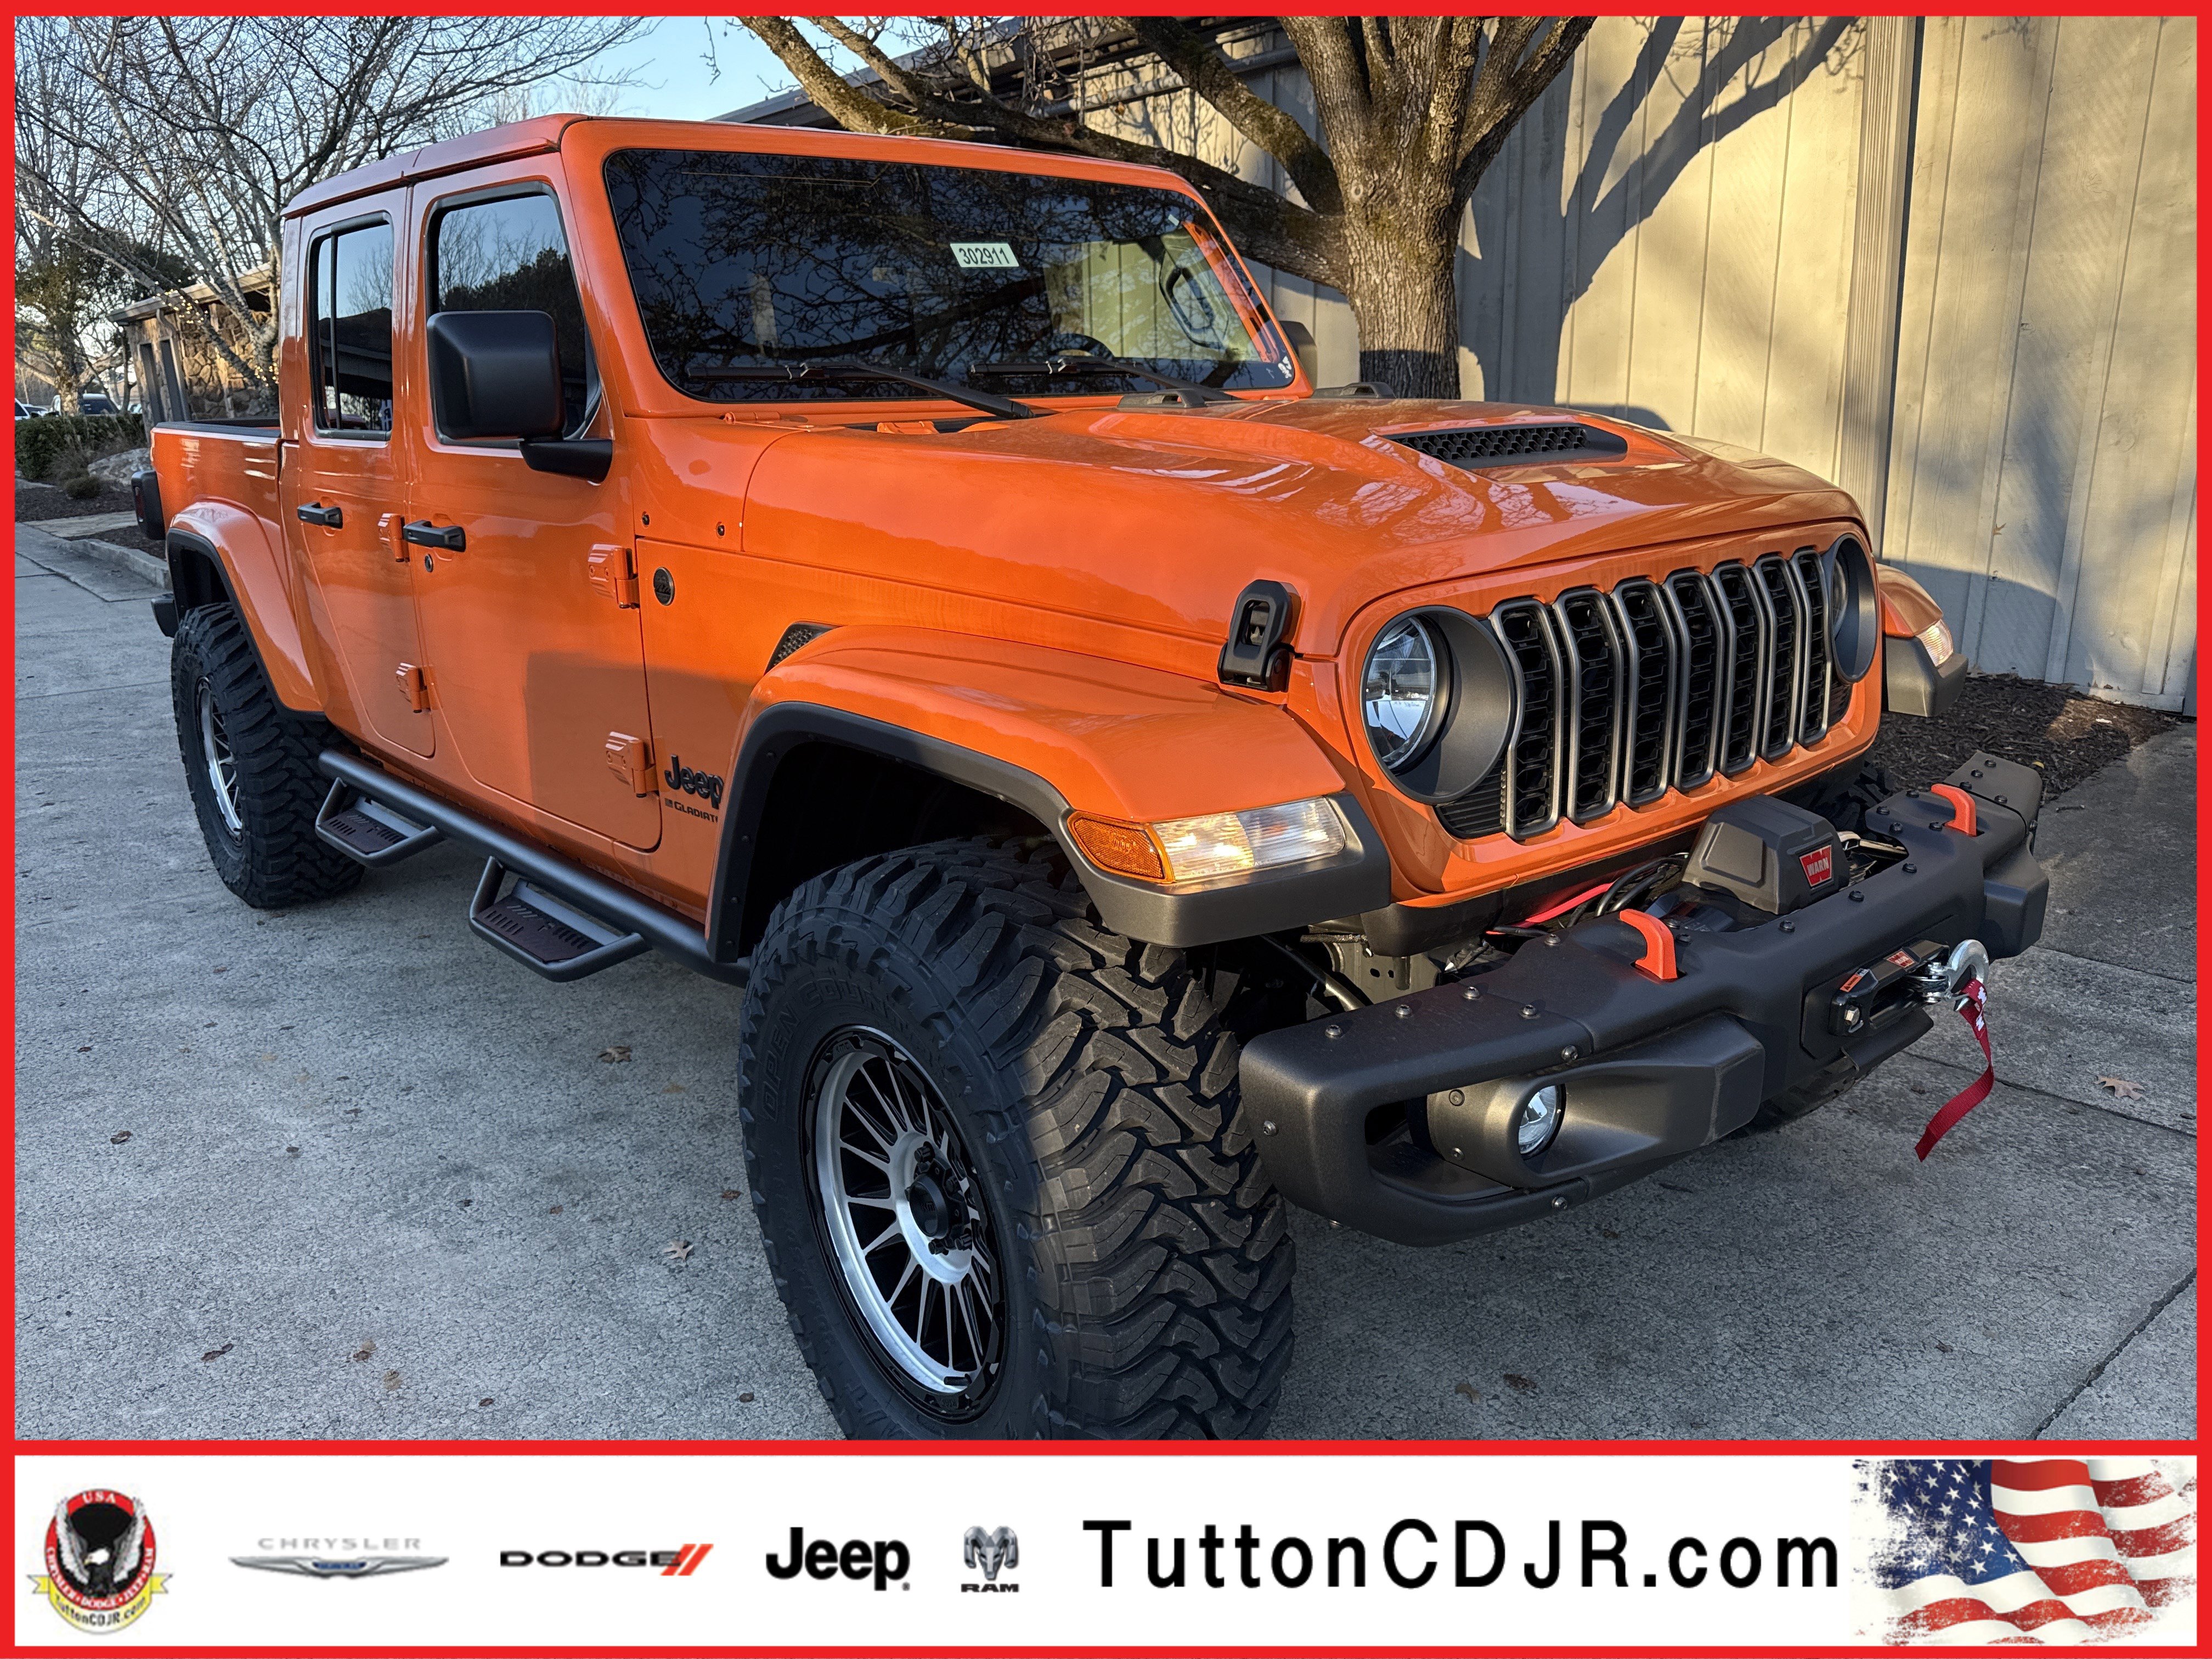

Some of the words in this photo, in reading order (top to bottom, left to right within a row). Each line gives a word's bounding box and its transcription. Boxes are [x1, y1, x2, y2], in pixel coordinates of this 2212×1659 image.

[958, 247, 1010, 265] 302911
[664, 754, 724, 810] Jeep
[674, 801, 718, 823] GLADIAT
[1806, 857, 1830, 877] WARN
